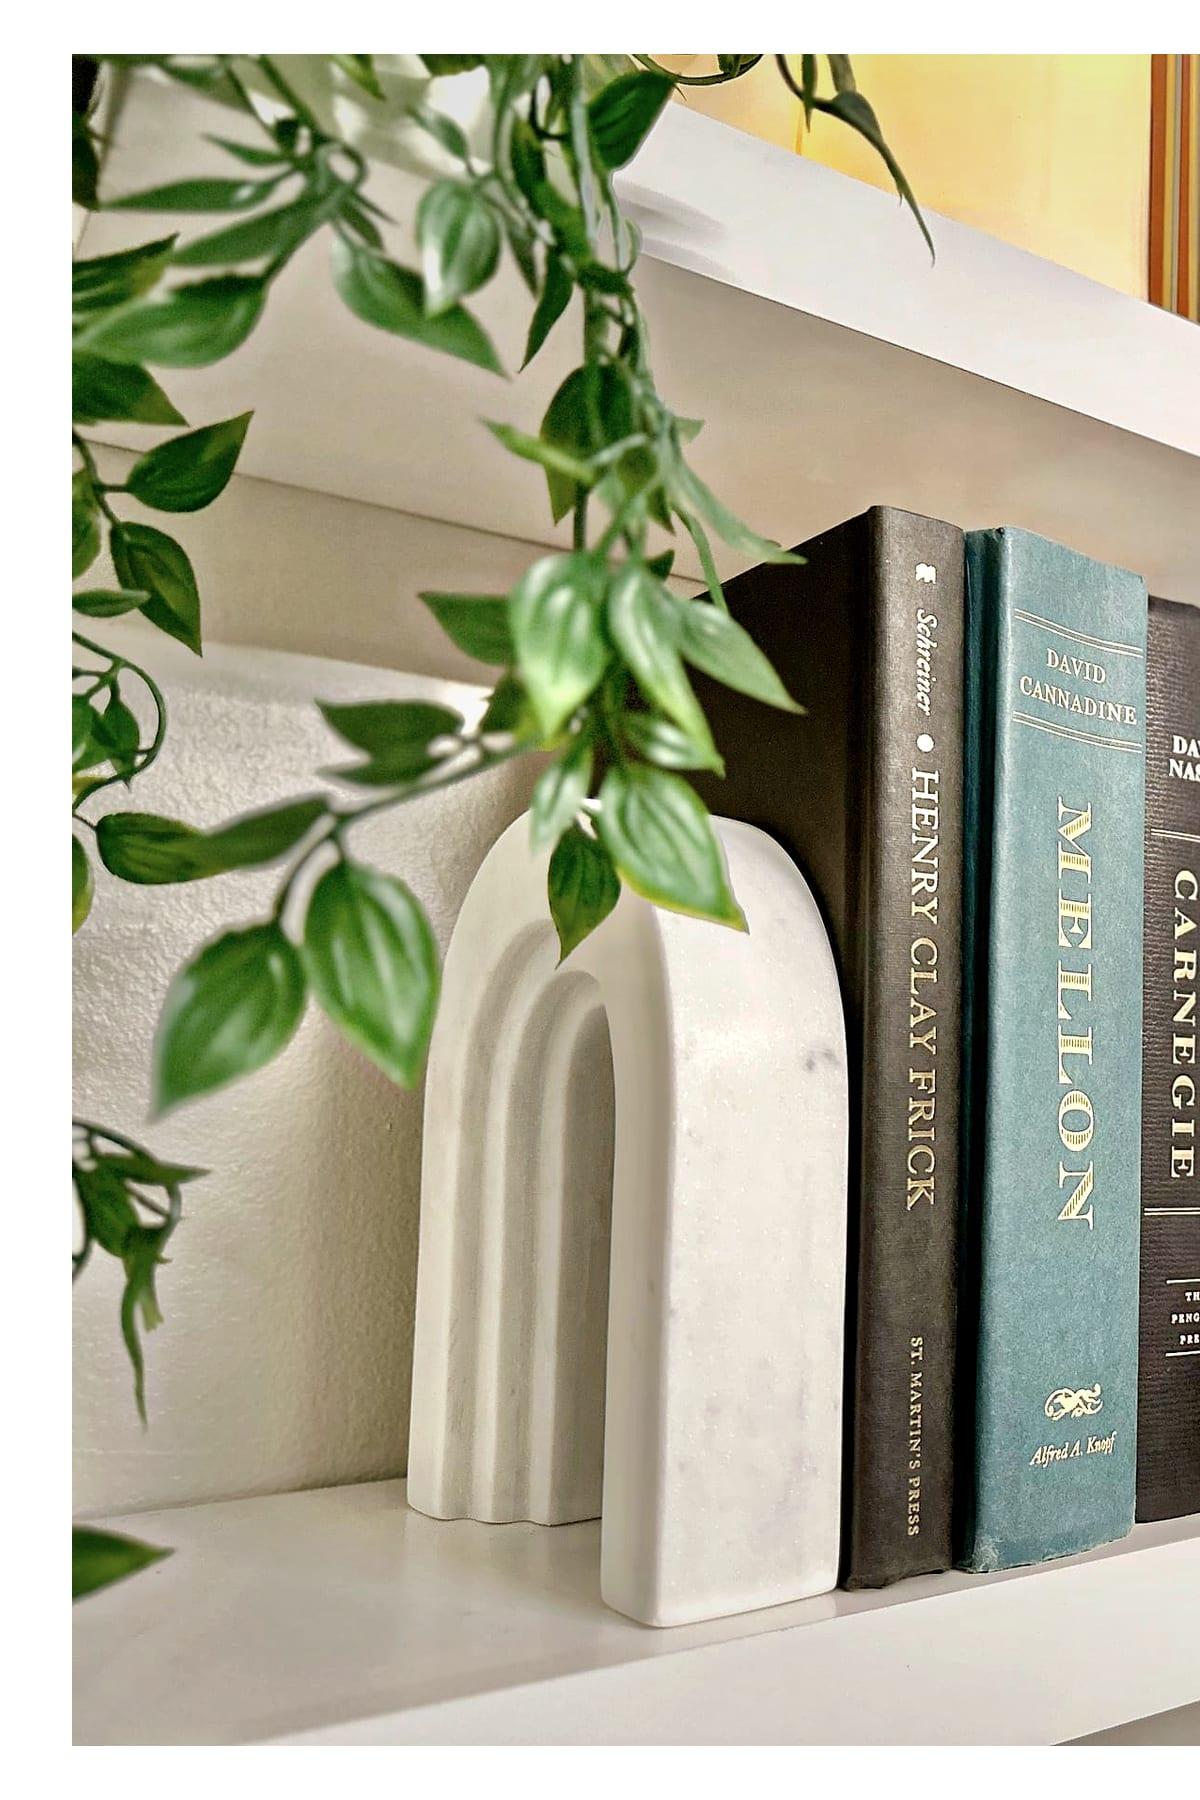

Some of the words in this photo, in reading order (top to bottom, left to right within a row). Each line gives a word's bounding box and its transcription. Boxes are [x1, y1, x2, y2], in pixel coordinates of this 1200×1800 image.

[915, 608, 938, 717] Schreiner
[1019, 675, 1138, 726] CANNADINE
[1045, 647, 1107, 684] DAVID
[910, 769, 939, 927] HENRY
[909, 937, 939, 1057] CLAY
[1056, 795, 1095, 1231] MELLON
[1171, 869, 1199, 1179] CARNEGIE
[906, 1067, 936, 1211] FRICK
[910, 1336, 924, 1366] ST.
[908, 1371, 923, 1471] MARTIN'S
[1028, 1441, 1070, 1469] Alfred
[1069, 1439, 1084, 1458] A.
[1086, 1430, 1118, 1455] Knopf
[907, 1475, 922, 1537] PRESS
